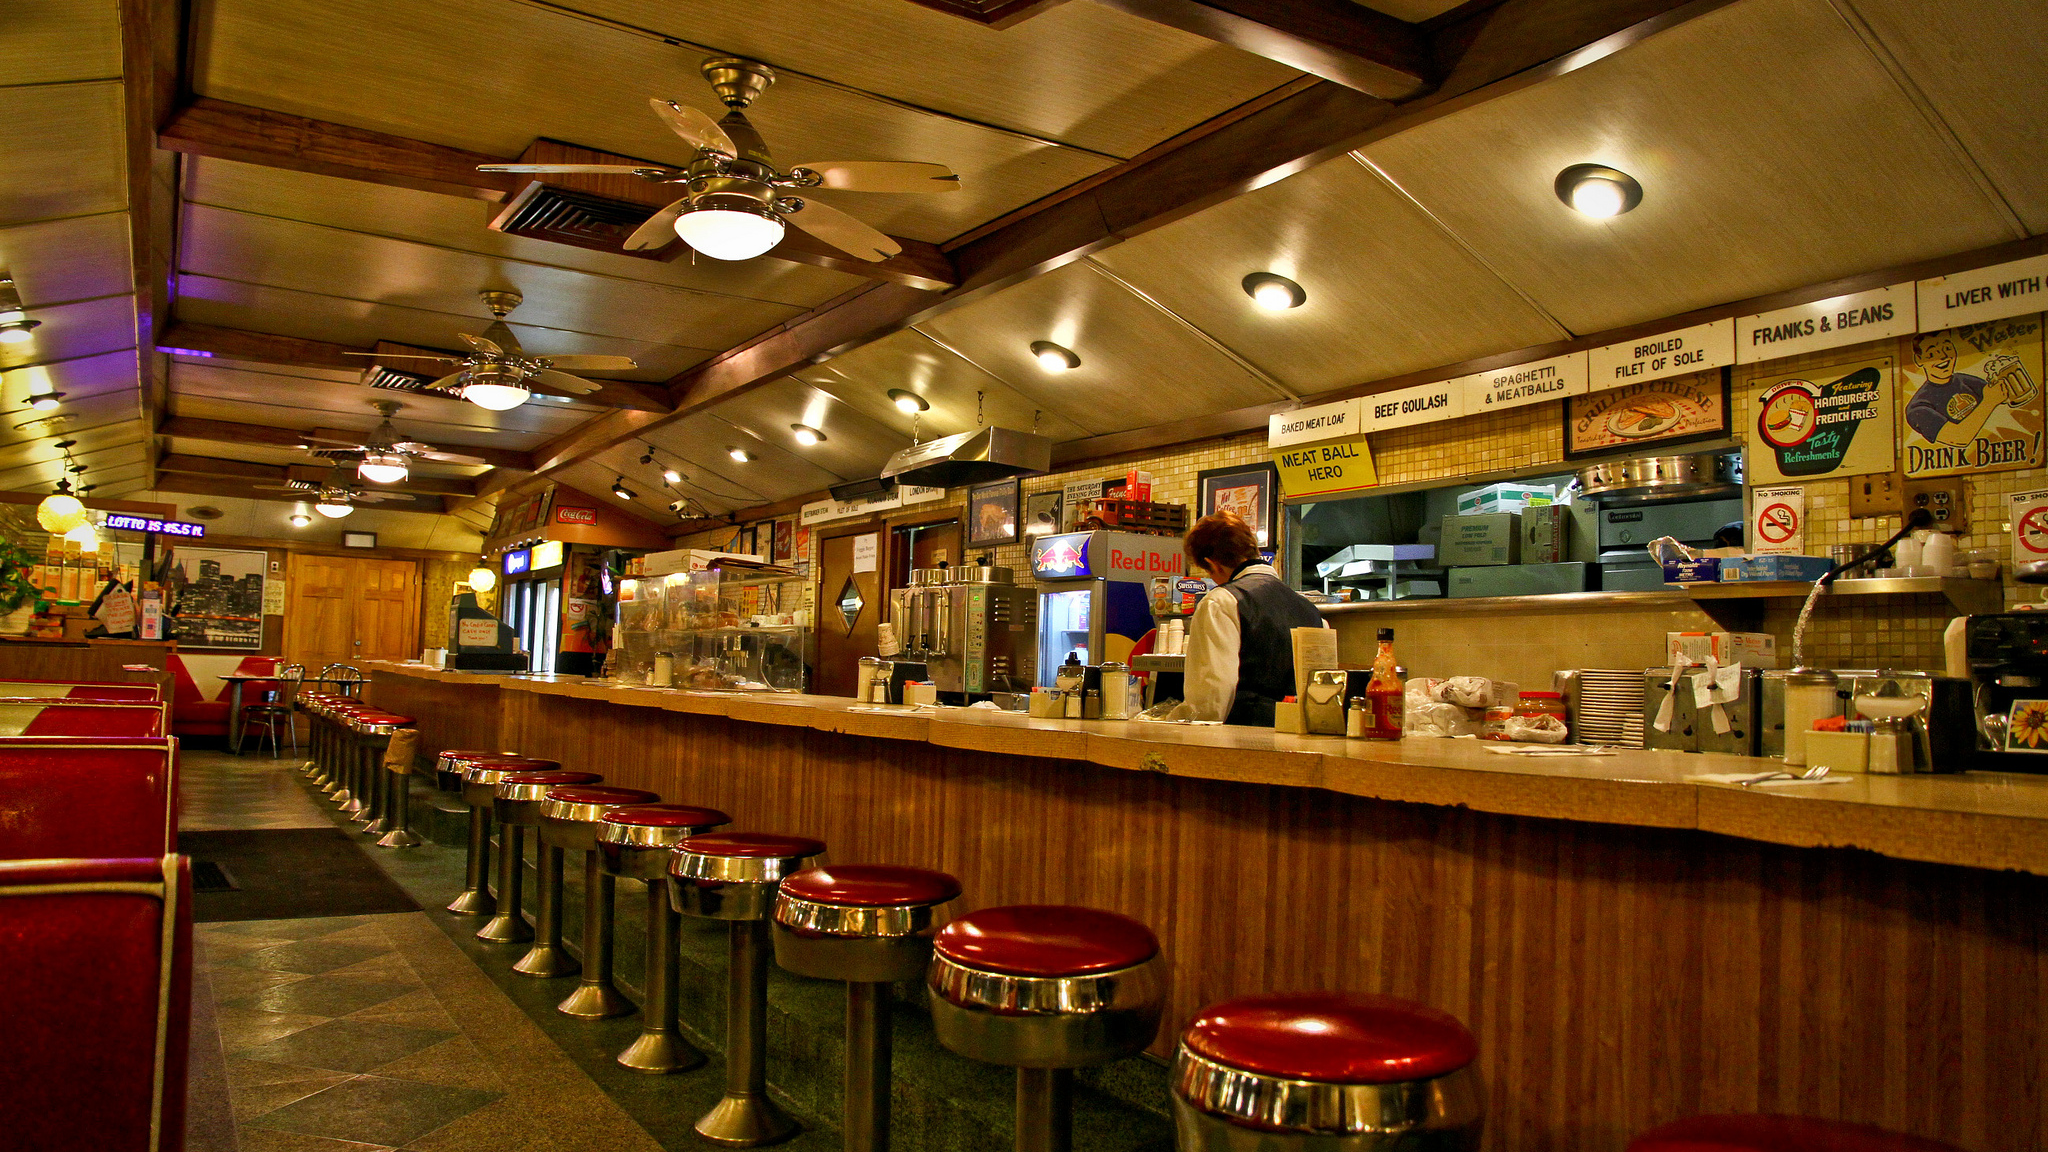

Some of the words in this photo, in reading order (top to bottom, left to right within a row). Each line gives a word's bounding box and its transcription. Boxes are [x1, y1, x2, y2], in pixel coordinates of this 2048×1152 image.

[1946, 286, 1992, 310] LIVER
[1998, 276, 2040, 298] WITH
[1753, 319, 1815, 346] FRANKS
[1820, 316, 1832, 332] &
[1837, 302, 1894, 330] BEANS
[1968, 321, 2039, 353] Water
[1634, 338, 1683, 359] BROILED
[1615, 362, 1646, 379] FILET
[1652, 358, 1667, 372] OF
[1674, 349, 1704, 367] SOLE
[1493, 366, 1556, 388] SPAGHETTI
[1485, 393, 1493, 404] &
[1496, 378, 1564, 402] MEATBALLS
[1814, 390, 1880, 409] HAMBURGERS
[1832, 381, 1873, 396] Featuring
[1374, 402, 1400, 419] BEEF
[1402, 394, 1448, 414] GOULASH
[1577, 384, 1644, 433] GRILLED
[1649, 380, 1714, 413] CHEESE
[1815, 410, 1850, 426] FRENCH
[1850, 408, 1878, 421] FRIES
[1281, 420, 1304, 435] BAKED
[1306, 416, 1326, 430] MEAT
[1326, 412, 1346, 426] LOAF
[1806, 430, 1841, 450] Tasty
[1282, 450, 1317, 468] MEAT
[1322, 444, 1360, 462] BALL
[1784, 449, 1841, 464] Refreshments
[1907, 446, 1972, 474] DRINK
[1308, 464, 1342, 482] HERO
[1067, 492, 1087, 500] EVENING
[1088, 490, 1102, 498] POST
[1076, 482, 1102, 492] SATURDAY
[108, 516, 146, 530] LOTTO
[148, 520, 162, 532] IS
[1111, 549, 1146, 571] Red
[1149, 552, 1182, 574] Bull
